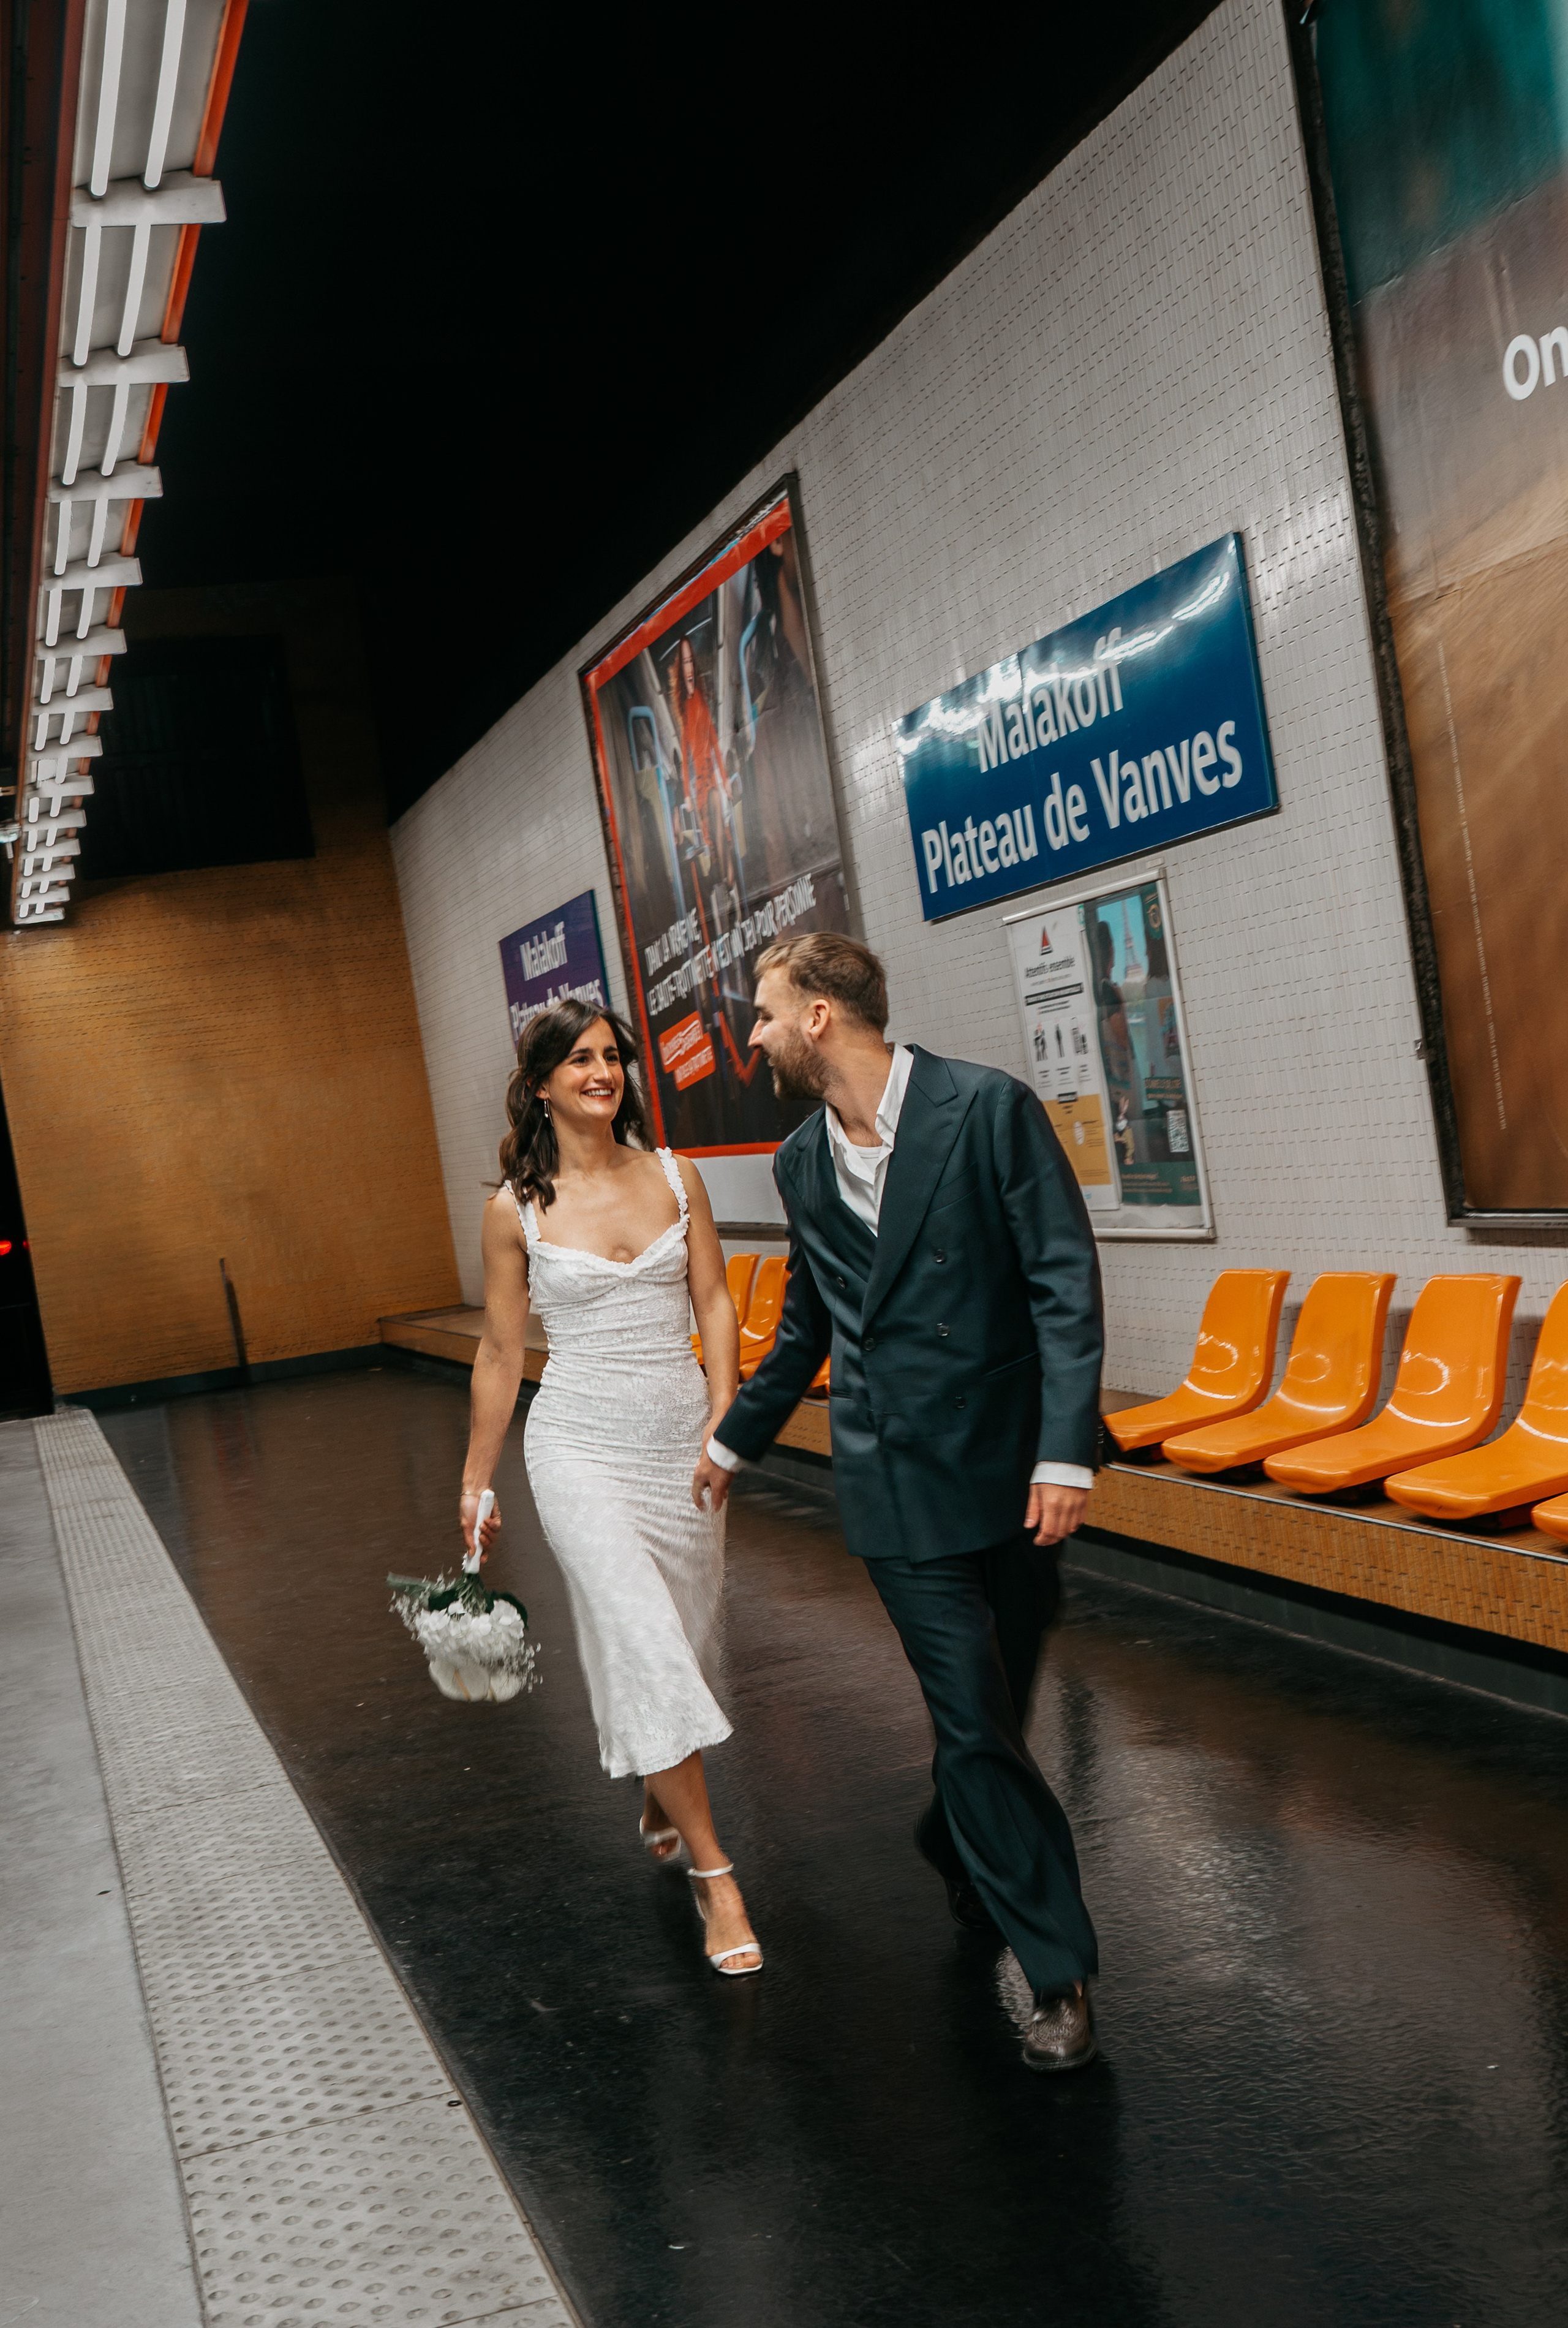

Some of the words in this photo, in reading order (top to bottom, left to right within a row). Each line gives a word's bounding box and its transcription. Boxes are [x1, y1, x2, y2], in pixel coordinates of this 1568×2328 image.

[978, 627, 1123, 774] Malakoff
[921, 804, 1038, 894] Plateau
[1044, 772, 1090, 850] de
[1090, 720, 1243, 830] Vanves
[519, 921, 568, 981] Malakoff
[754, 900, 779, 946] POUR
[774, 873, 816, 932] PERSONNE
